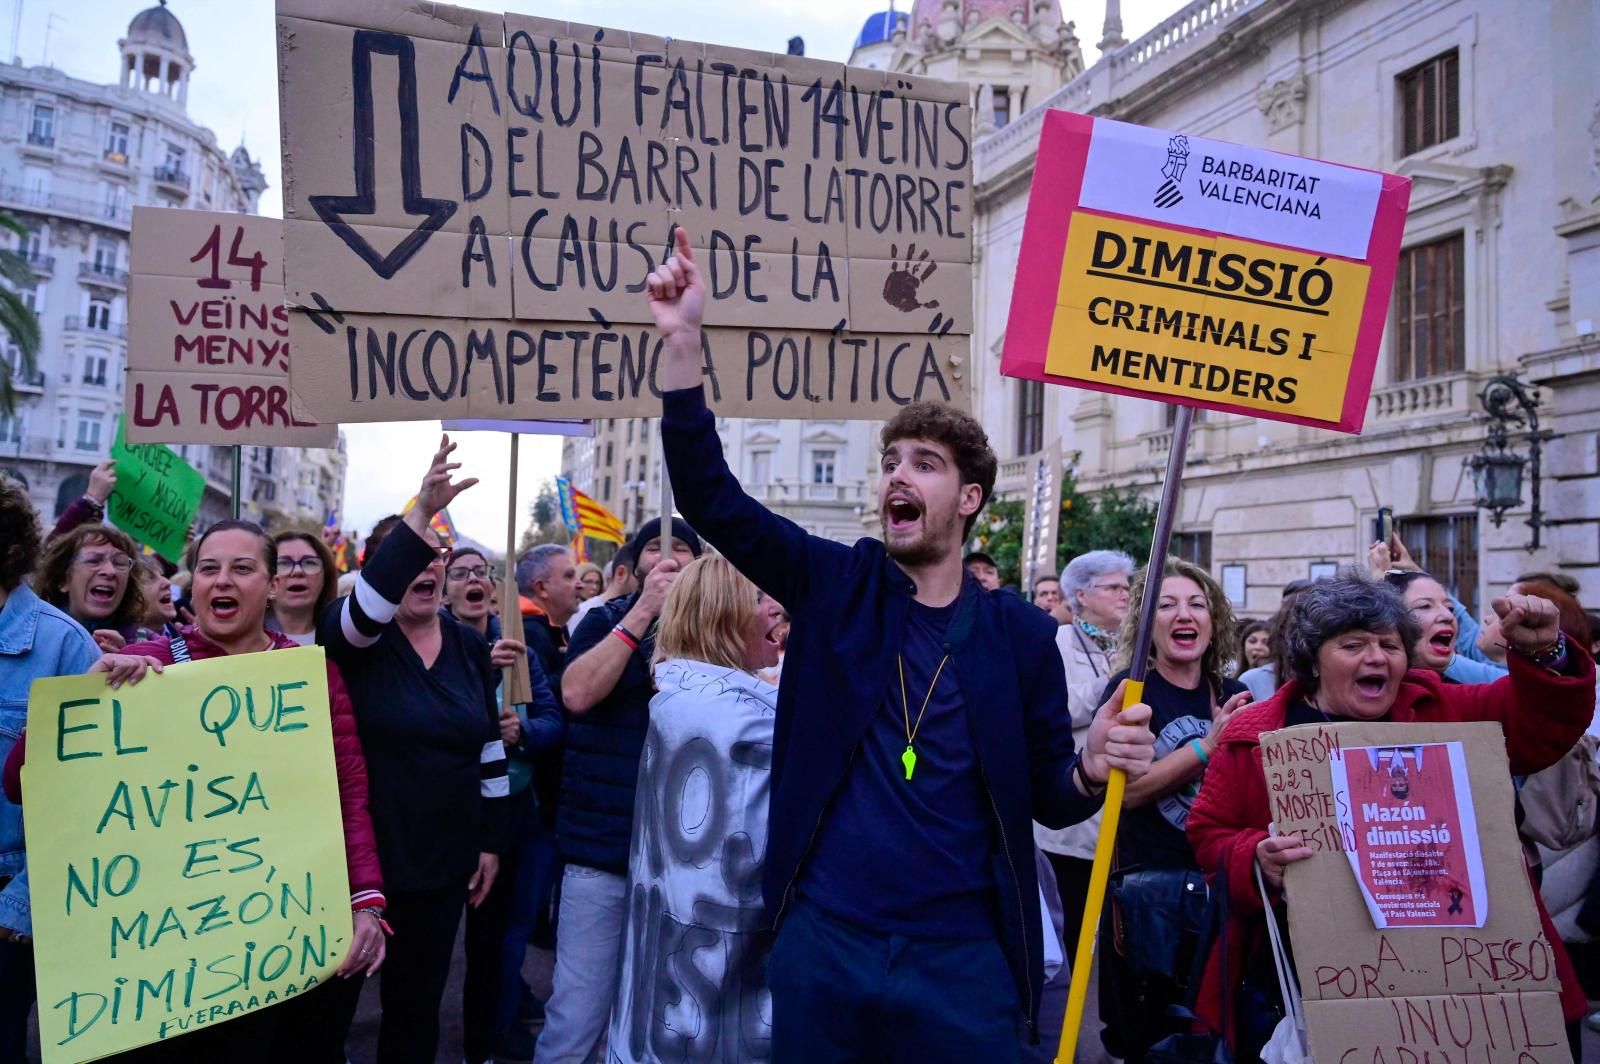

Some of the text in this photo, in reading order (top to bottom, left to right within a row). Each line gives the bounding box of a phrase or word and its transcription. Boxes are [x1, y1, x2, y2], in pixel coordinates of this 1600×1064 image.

[634, 54, 789, 152] FALTEN
[461, 122, 560, 202] DEL
[576, 130, 717, 210] BARRI
[738, 157, 789, 221] DE
[1199, 178, 1322, 220] VALENCIANA
[1201, 156, 1320, 195] BARBARITAT
[190, 224, 268, 291] 14
[461, 215, 497, 288] A
[709, 229, 768, 303] DE
[791, 237, 840, 302] LA
[1090, 230, 1334, 306] DIMISSIÓ
[1087, 296, 1317, 361] CRIMINALS I
[1090, 345, 1298, 404] MENTIDERS
[133, 382, 318, 431] LA TORR
[56, 680, 309, 762] EL QUE
[1265, 726, 1342, 767] MAZÓN
[1272, 768, 1314, 792] 229
[1275, 786, 1348, 824] MORTES
[1362, 800, 1426, 823] Mazón
[1366, 823, 1451, 846] dimissió
[65, 854, 140, 916] NO
